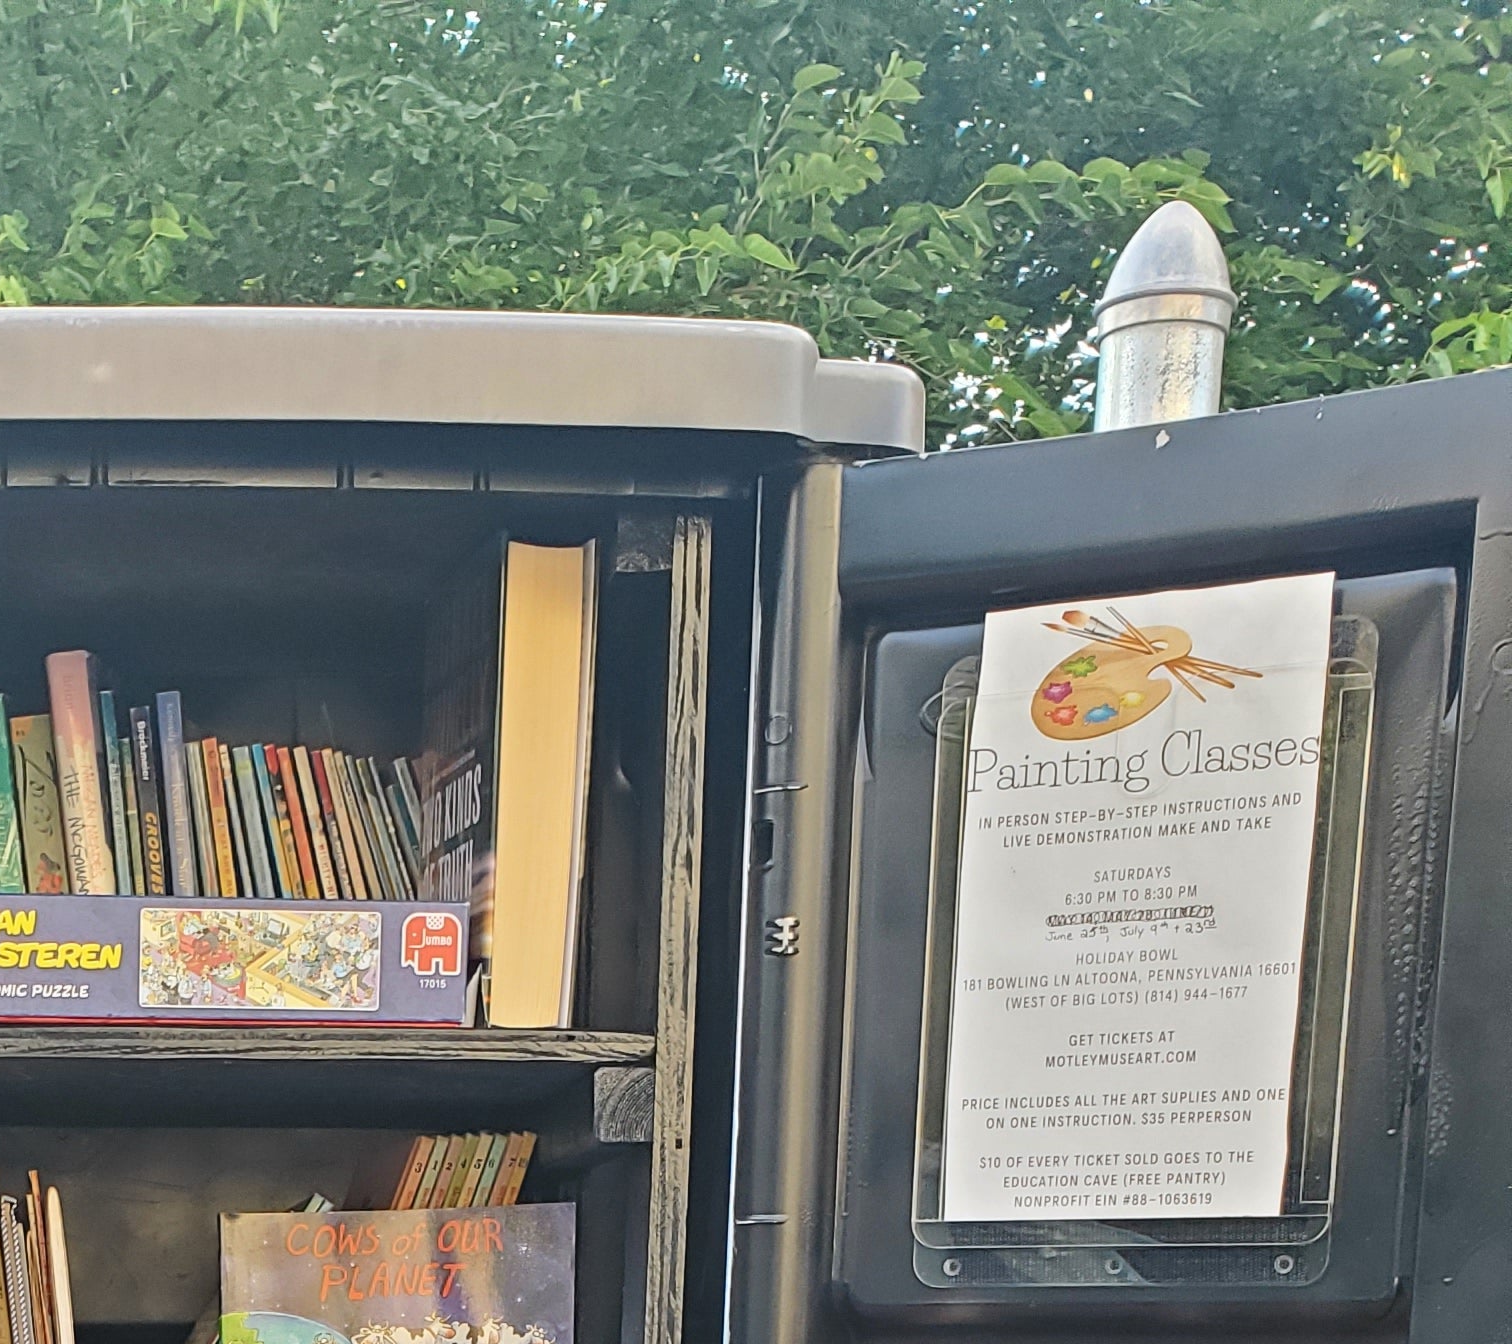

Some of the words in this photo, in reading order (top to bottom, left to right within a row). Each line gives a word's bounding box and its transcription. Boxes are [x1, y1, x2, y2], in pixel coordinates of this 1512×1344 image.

[967, 748, 1149, 793] Painting
[1161, 729, 1320, 777] Classes
[137, 720, 151, 781] Brockmeier
[144, 812, 165, 895] GROOVES
[444, 763, 482, 842] KINDS
[978, 817, 992, 830] IN
[997, 812, 1050, 829] PERSON
[1054, 804, 1158, 825] STEP-BY-STEP
[1163, 794, 1267, 817] INSTRUCTIONS
[1271, 792, 1302, 807] AND
[1002, 834, 1031, 849] LIVE
[1036, 824, 1152, 846] DEMONSTRATION
[1158, 821, 1196, 837] MAKE
[1200, 818, 1231, 834] AND
[1236, 815, 1272, 831] TAKE
[438, 839, 474, 901] TRUTH
[1093, 865, 1172, 884] SATURDAYS
[1064, 891, 1093, 906] 6:30
[1097, 890, 1117, 904] PM
[1121, 888, 1139, 903] TO
[1144, 886, 1173, 901] 8:30
[1178, 884, 1198, 898] PM
[1075, 950, 1135, 967] HOLIDAY
[1139, 948, 1179, 963] BOWL
[419, 979, 448, 990] 17015
[962, 979, 982, 992] 181
[987, 974, 1049, 991] BOWLING
[1054, 974, 1070, 987] LN
[1075, 970, 1143, 986] ALTOONA,
[1148, 964, 1253, 983] PENNSYLVANIA
[1259, 962, 1297, 976] 16601
[31, 984, 90, 999] PUZZLE
[1005, 995, 1046, 1012] (WEST
[1050, 994, 1068, 1007] OF
[1072, 993, 1096, 1006] BIG
[1100, 990, 1139, 1005] LOTS)
[1144, 988, 1179, 1005] (814)
[1183, 985, 1249, 1002] 944-1677
[1068, 1033, 1094, 1047] GET
[1099, 1030, 1154, 1046] TICKETS
[1157, 1029, 1176, 1044] AT
[1045, 1049, 1197, 1068] MOTLEYMUSEART.COM
[961, 1097, 1000, 1111] PRICE
[1004, 1095, 1070, 1110] INCLUDES
[1074, 1094, 1098, 1108] ALL
[1102, 1093, 1127, 1107] THE
[1131, 1092, 1158, 1105] ART
[1161, 1090, 1217, 1104] SUPLIES
[1221, 1089, 1251, 1102] AND
[1256, 1087, 1286, 1101] ONE
[985, 1117, 1005, 1130] ON
[1010, 1116, 1038, 1129] ONE
[1042, 1113, 1137, 1129] INSTRUCTION.
[1140, 1111, 1165, 1125] $35
[1170, 1109, 1253, 1124] PERPERSON
[979, 1156, 1001, 1169] $10
[1006, 1156, 1023, 1168] OF
[1027, 1155, 1070, 1168] EVERY
[1074, 1153, 1121, 1167] TICKET
[1124, 1152, 1159, 1166] SOLD
[1163, 1151, 1200, 1165] GOES
[1206, 1151, 1223, 1164] TO
[1228, 1150, 1256, 1163] THE
[1003, 1174, 1079, 1189] EDUCATION
[1083, 1174, 1118, 1187] CAVE
[1123, 1173, 1161, 1187] (FREE
[1166, 1171, 1227, 1186] PANTRY)
[1013, 1194, 1091, 1208] NONPROFIT
[1094, 1194, 1117, 1207] EIN
[1122, 1192, 1213, 1206] #88-1063619
[286, 1222, 381, 1258] COWS
[392, 1222, 427, 1256] of
[437, 1217, 505, 1253] OUR
[319, 1262, 467, 1302] PLANET
